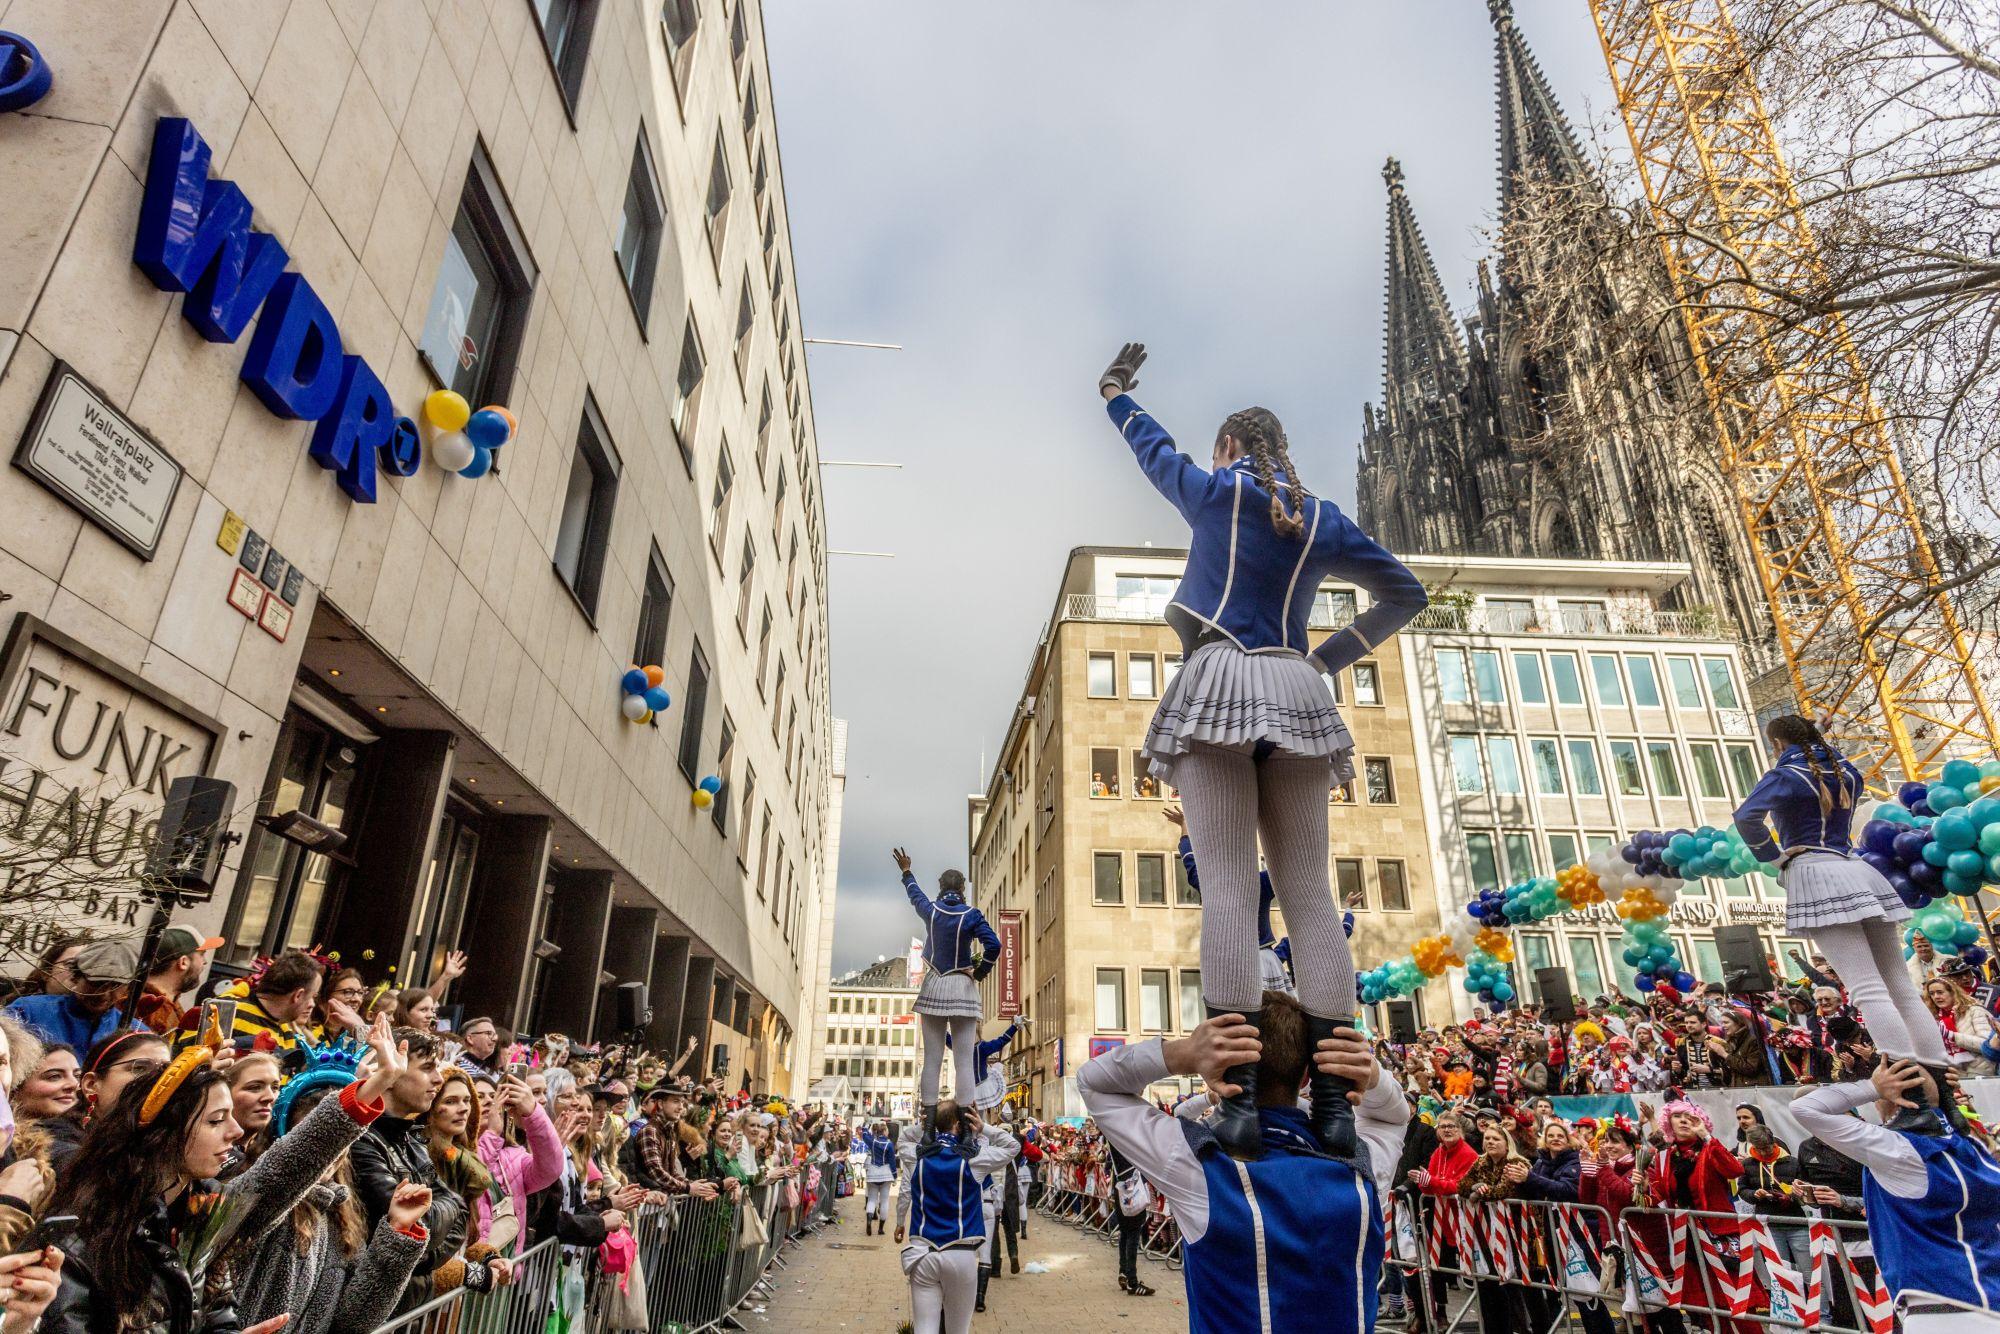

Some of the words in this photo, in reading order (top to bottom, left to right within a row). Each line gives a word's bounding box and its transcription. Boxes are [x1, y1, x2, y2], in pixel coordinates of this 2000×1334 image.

[133, 116, 393, 504] WDR
[79, 424, 109, 454] Ferdinand
[110, 450, 127, 468] Franz
[85, 403, 154, 473] Wallrafplatz
[5, 667, 192, 800] FUNK
[83, 888, 141, 926] BAR
[1732, 902, 1786, 914] IMMOBILIEN
[1006, 928, 1014, 1000] LEDERER
